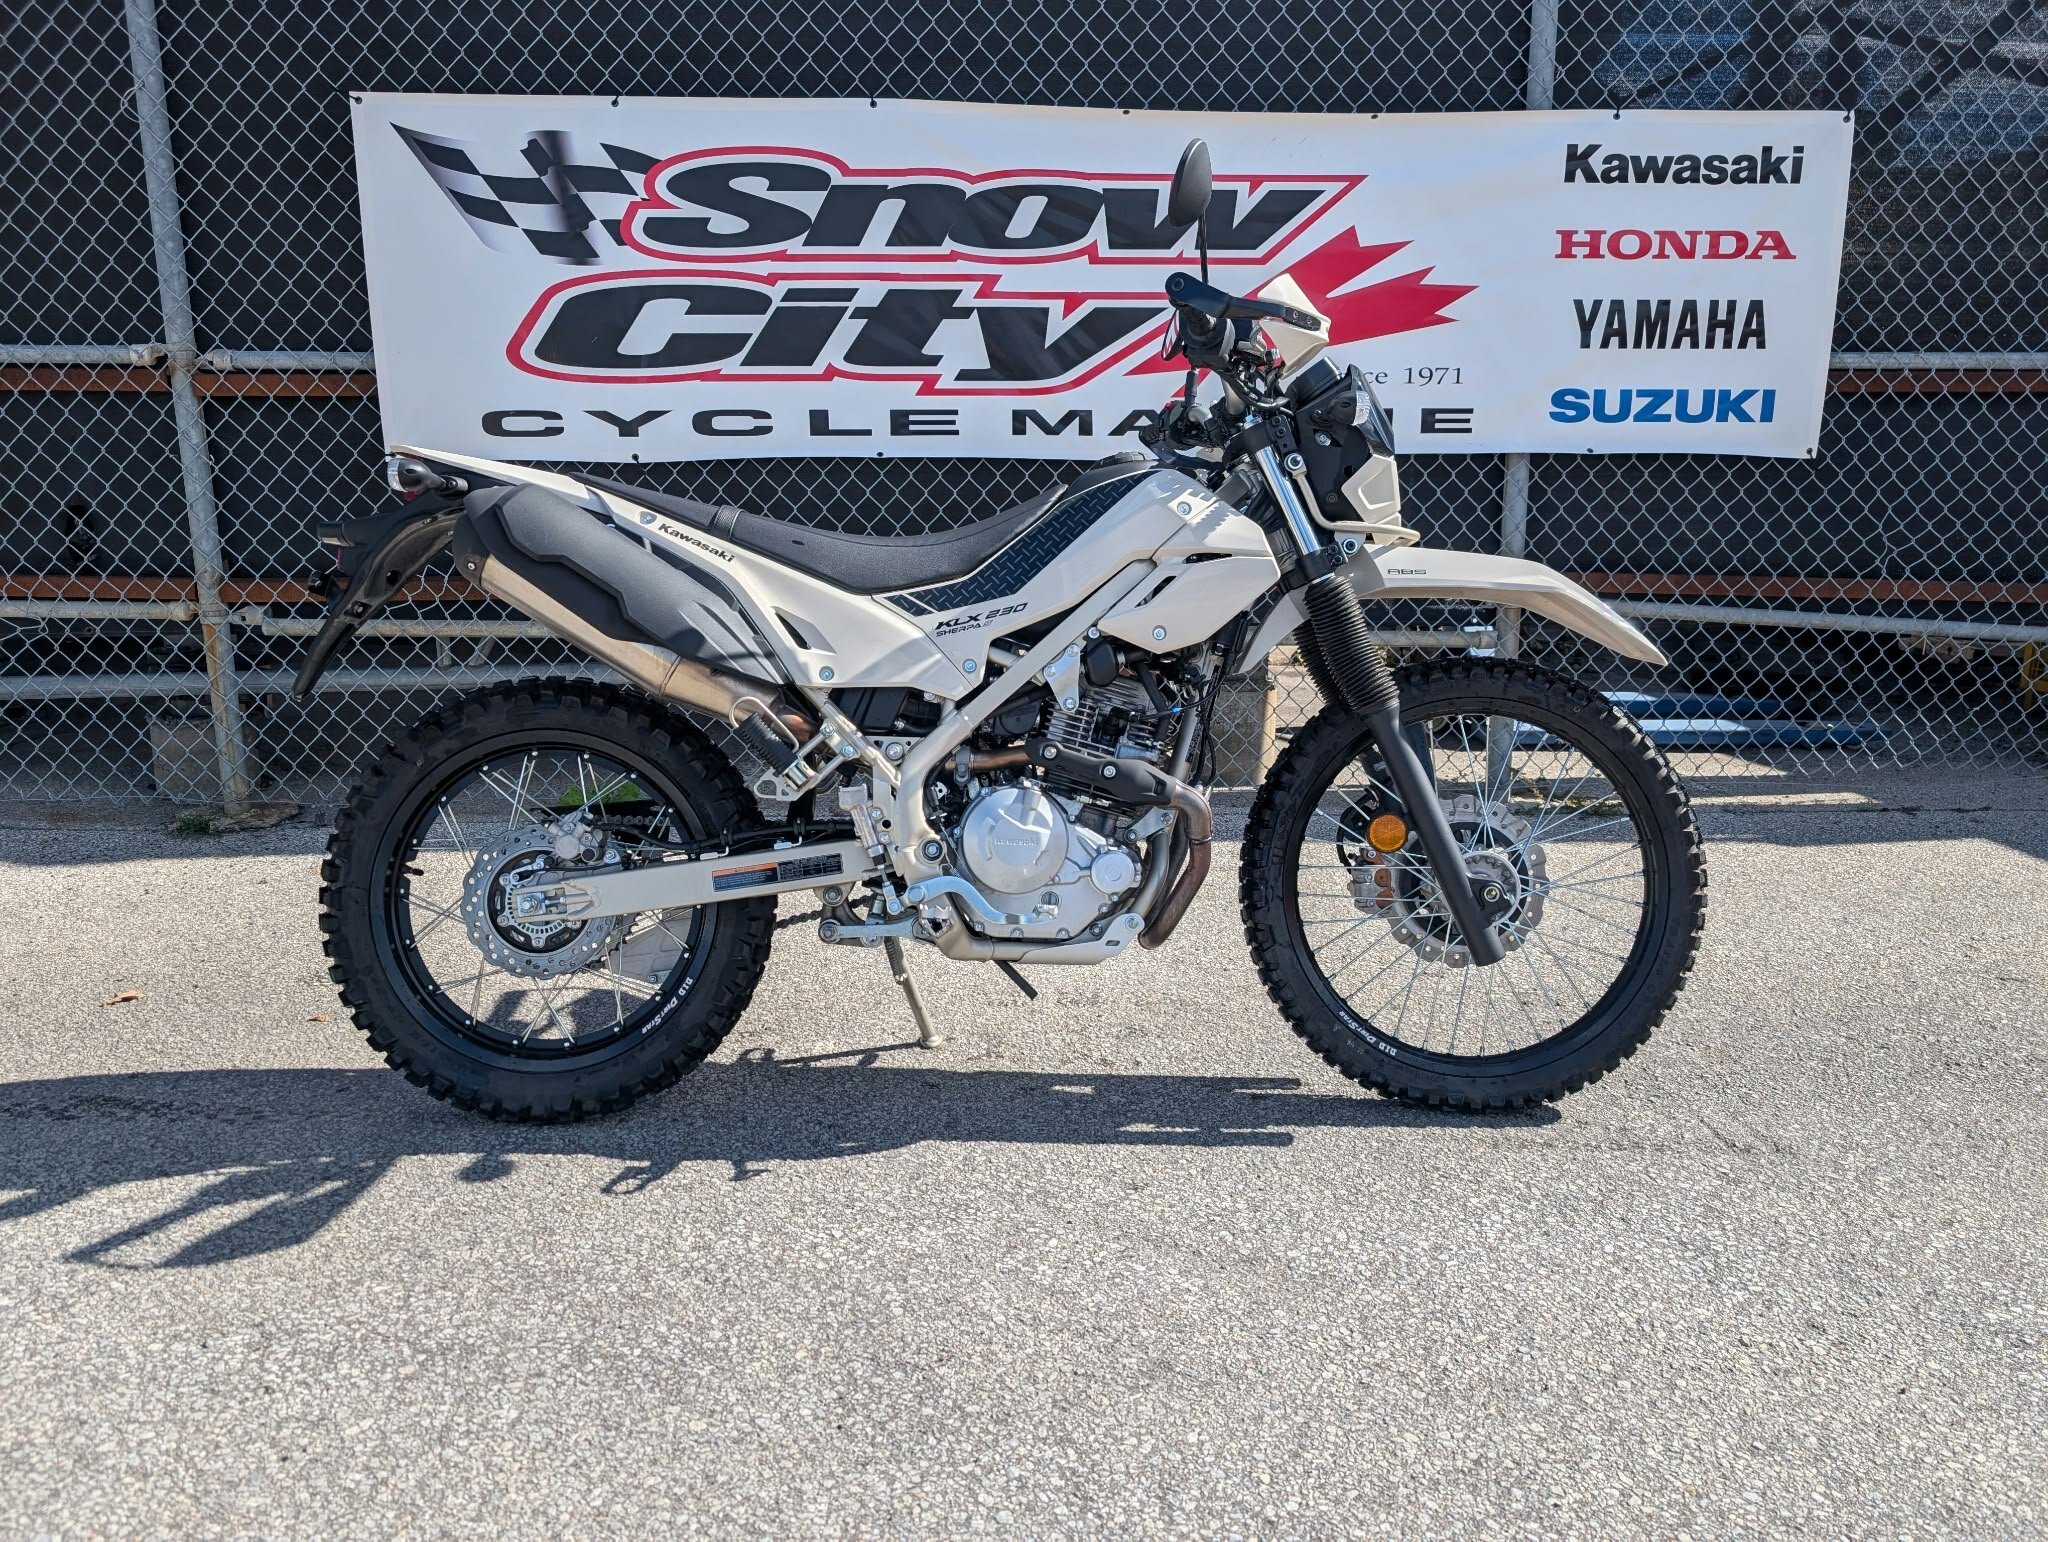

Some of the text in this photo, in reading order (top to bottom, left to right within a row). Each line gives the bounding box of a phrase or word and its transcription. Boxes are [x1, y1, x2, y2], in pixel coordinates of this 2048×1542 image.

[1563, 143, 1805, 185] Kawasaki
[641, 160, 1326, 251] Snow
[1555, 230, 1797, 260] HONDA
[534, 284, 1169, 382] City
[1573, 298, 1767, 350] YAMAHA
[1403, 366, 1464, 387] 1971
[1548, 387, 1777, 424] SUZUKI
[481, 408, 1475, 438] CYCLE MAE
[658, 523, 735, 563] Kawasaki
[1387, 568, 1427, 576] ABS
[934, 612, 984, 631] KLX
[984, 602, 1029, 620] 230
[935, 622, 982, 638] SHERPA
